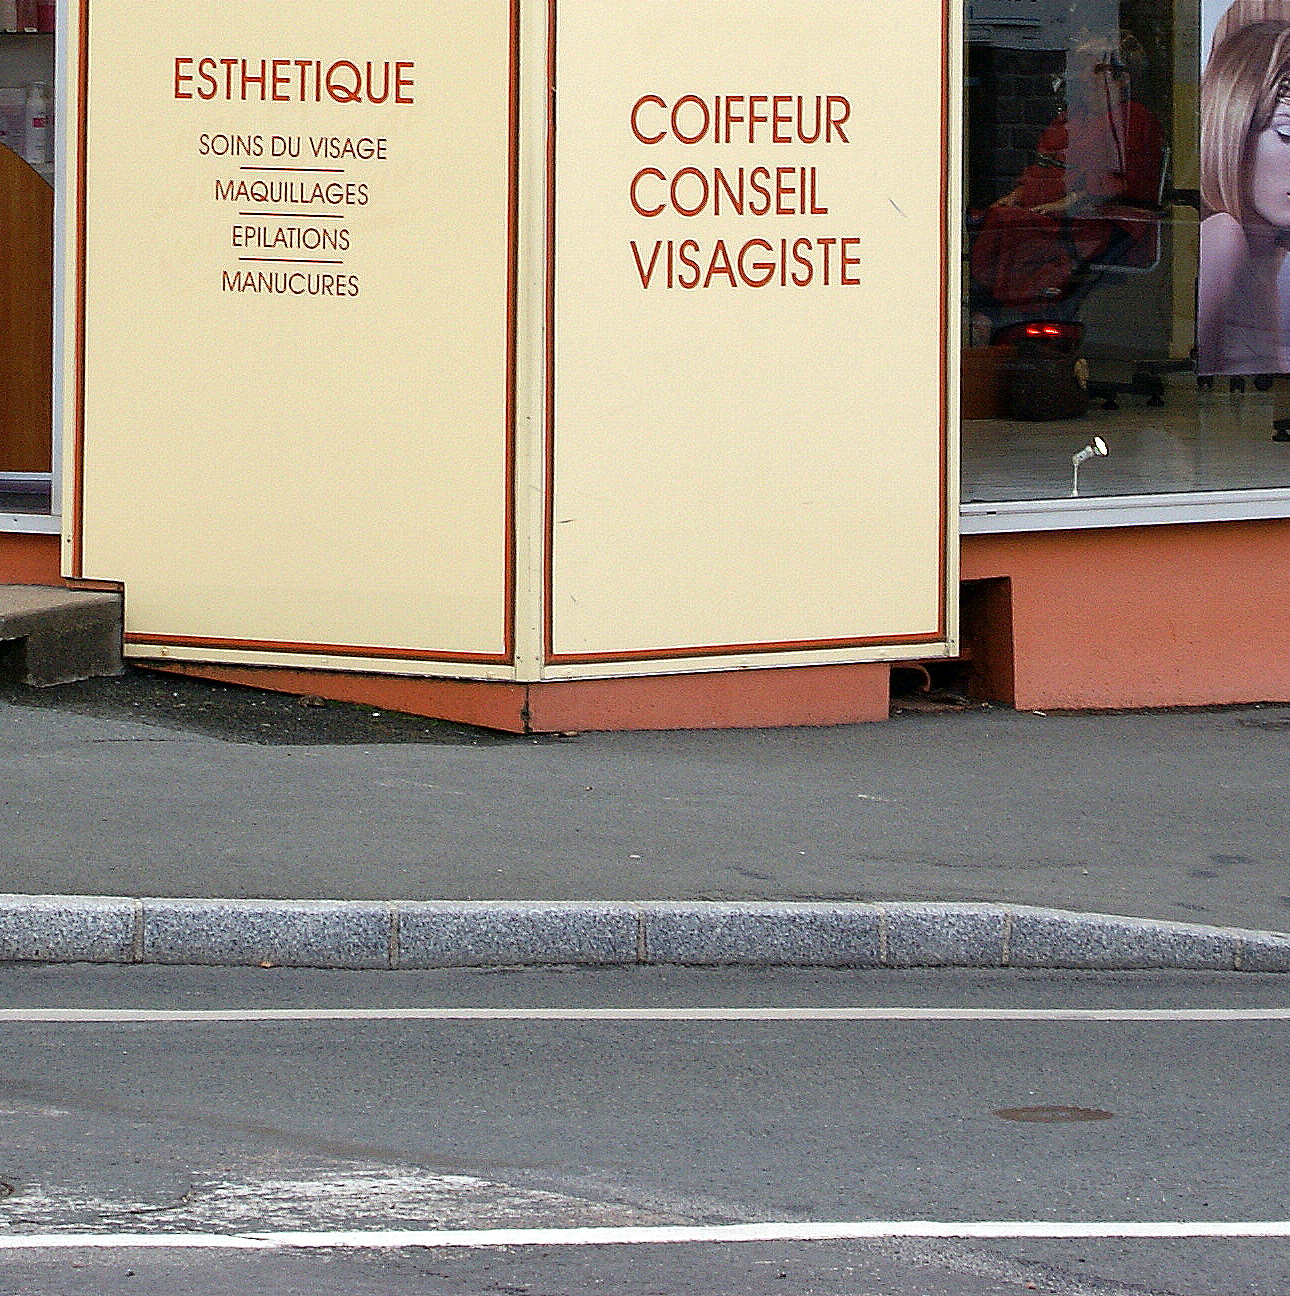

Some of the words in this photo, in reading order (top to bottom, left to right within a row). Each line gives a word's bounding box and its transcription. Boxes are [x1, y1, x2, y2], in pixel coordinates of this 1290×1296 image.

[174, 57, 415, 105] ESTHETIQUE
[630, 94, 852, 145] COIFFEUR
[199, 134, 264, 157] SOINS
[271, 136, 301, 158] DU
[309, 137, 388, 160] VISAGE
[215, 180, 370, 206] MAQUILLAGES
[629, 166, 830, 218] CONSEIL
[232, 226, 351, 251] EPILATIONS
[629, 238, 862, 290] VISAGISTE
[222, 271, 360, 297] MANUCURES
